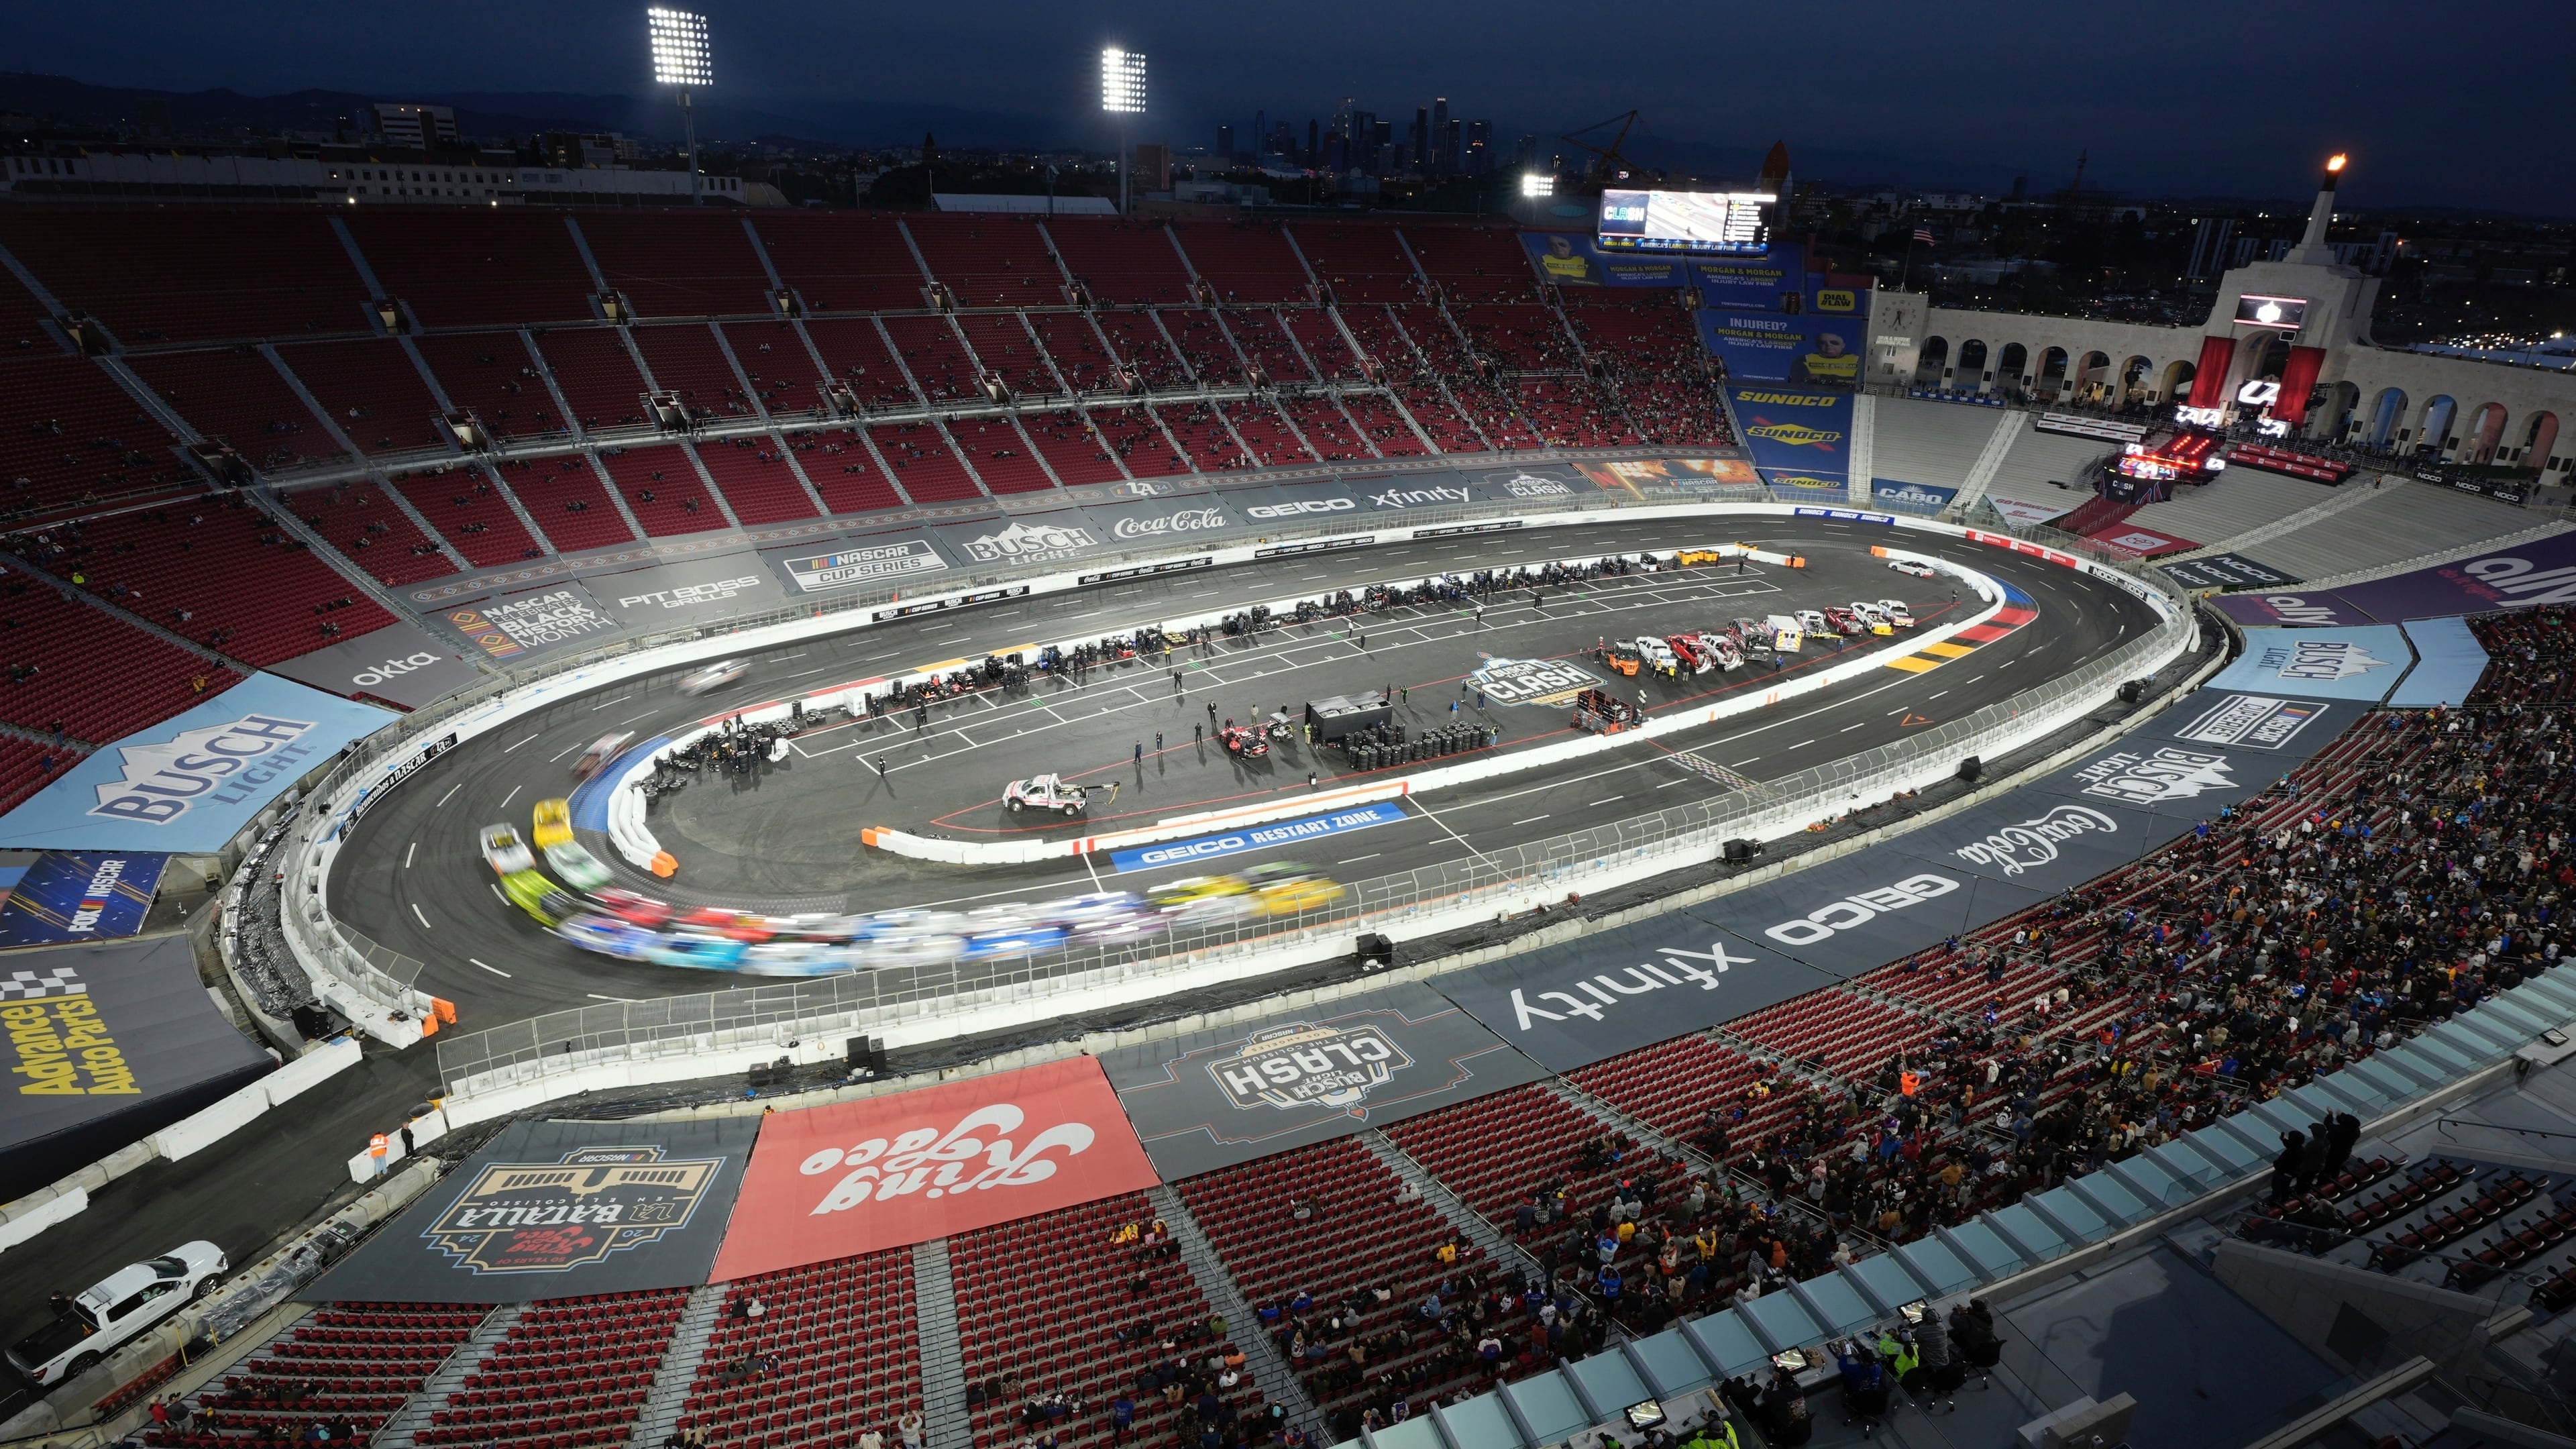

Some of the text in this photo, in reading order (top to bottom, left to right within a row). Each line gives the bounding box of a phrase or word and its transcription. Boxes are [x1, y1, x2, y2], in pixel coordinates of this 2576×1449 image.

[1604, 206, 1644, 222] CLASH
[1700, 266, 1782, 276] MORGAN & MORGAN
[1730, 317, 1787, 331] INJURED?
[1718, 328, 1754, 337] MORGAN
[1765, 332, 1803, 341] MORGAN
[1736, 390, 1837, 407] SUNOCO
[1750, 427, 1836, 441] SUNOCO
[1776, 478, 1835, 488] SUNOCO
[2417, 472, 2443, 482] NOCO
[2455, 481, 2481, 492] NOCO
[1126, 482, 1159, 496] LA
[1368, 486, 1470, 508] xfinity
[1511, 484, 1570, 496] CLASH
[1643, 483, 1761, 494] FULL SPEED
[1878, 488, 1943, 504] CABO
[2493, 490, 2519, 502] NOCO
[1247, 498, 1356, 518] GEICO
[1830, 511, 1858, 519] SUNOCO
[2006, 512, 2043, 521] BOWLING
[2016, 501, 2060, 513] BOWLING
[1114, 506, 1226, 537] Coca-Cola
[1861, 515, 1889, 523] SUNOCO
[964, 529, 1097, 561] BUSCH
[1984, 536, 2001, 544] TOYOTA
[2018, 544, 2035, 553] TOYOTA
[2090, 538, 2143, 557] TOYOTA
[837, 546, 910, 566] NASCAR
[1007, 548, 1080, 565] LIGHT
[2050, 554, 2066, 564] TOYOTA
[820, 558, 922, 582] CUP SERIES
[2092, 568, 2118, 584] NOCO
[2163, 566, 2210, 585] NOCO
[2190, 561, 2244, 583] NOCO
[2215, 556, 2282, 582] NOCO
[1007, 587, 1023, 595] BUSCH
[2124, 580, 2145, 598] NOCO
[2464, 557, 2576, 607] ally
[618, 576, 761, 608] PIT BOSS
[662, 590, 737, 608] GRILLS
[945, 597, 962, 606] BUSCH
[975, 592, 1000, 602] CUP SERIES
[482, 590, 575, 619] NASCAR
[492, 597, 581, 624] CELEBRATES
[2267, 596, 2339, 625] ally
[498, 604, 592, 633] BLACK
[879, 610, 898, 619] BUSCH
[508, 611, 597, 639] HISTORY
[517, 617, 613, 648] MONTH
[2258, 647, 2290, 669] LIGHT
[2282, 641, 2350, 680] BUSCH
[353, 651, 442, 687] okta
[1491, 661, 1537, 678] BUSCH
[1481, 666, 1592, 699] CLASH
[1548, 682, 1585, 694] COLISEUM
[2206, 703, 2267, 737] CUP SERIES
[2249, 714, 2302, 743] NASCAR
[91, 715, 312, 823] BUSCH
[211, 743, 312, 806] LIGHT
[2077, 751, 2142, 783] LIGHT
[2081, 747, 2226, 804] BUSCH
[355, 751, 427, 817] Bienvenidos NASCAR
[1141, 810, 1382, 863] GEICO RESTART ZONE
[1956, 805, 2118, 877] Coca-Cola
[68, 860, 127, 932] FOX NASCAR
[1764, 873, 1960, 945] GEICO
[1509, 941, 1756, 1031] xfinity
[1252, 1031, 1326, 1053] LOS ANGELES
[1261, 1028, 1293, 1041] NASCAR
[1311, 1038, 1329, 1046] THE
[0, 1005, 86, 1095] Advance
[1242, 1045, 1303, 1064] COLISEUM
[1222, 1036, 1391, 1095] CLASH
[1291, 1071, 1367, 1099] BUSCH
[1302, 1070, 1340, 1085] LIGHT
[800, 1104, 1024, 1175] Taco
[578, 1153, 630, 1163] NASCAR
[808, 1122, 1095, 1217] King
[455, 1203, 675, 1227] LA BATALLA
[459, 1234, 482, 1242] 24
[513, 1226, 584, 1240] Taco
[623, 1229, 645, 1238] 20
[505, 1236, 594, 1255] King
